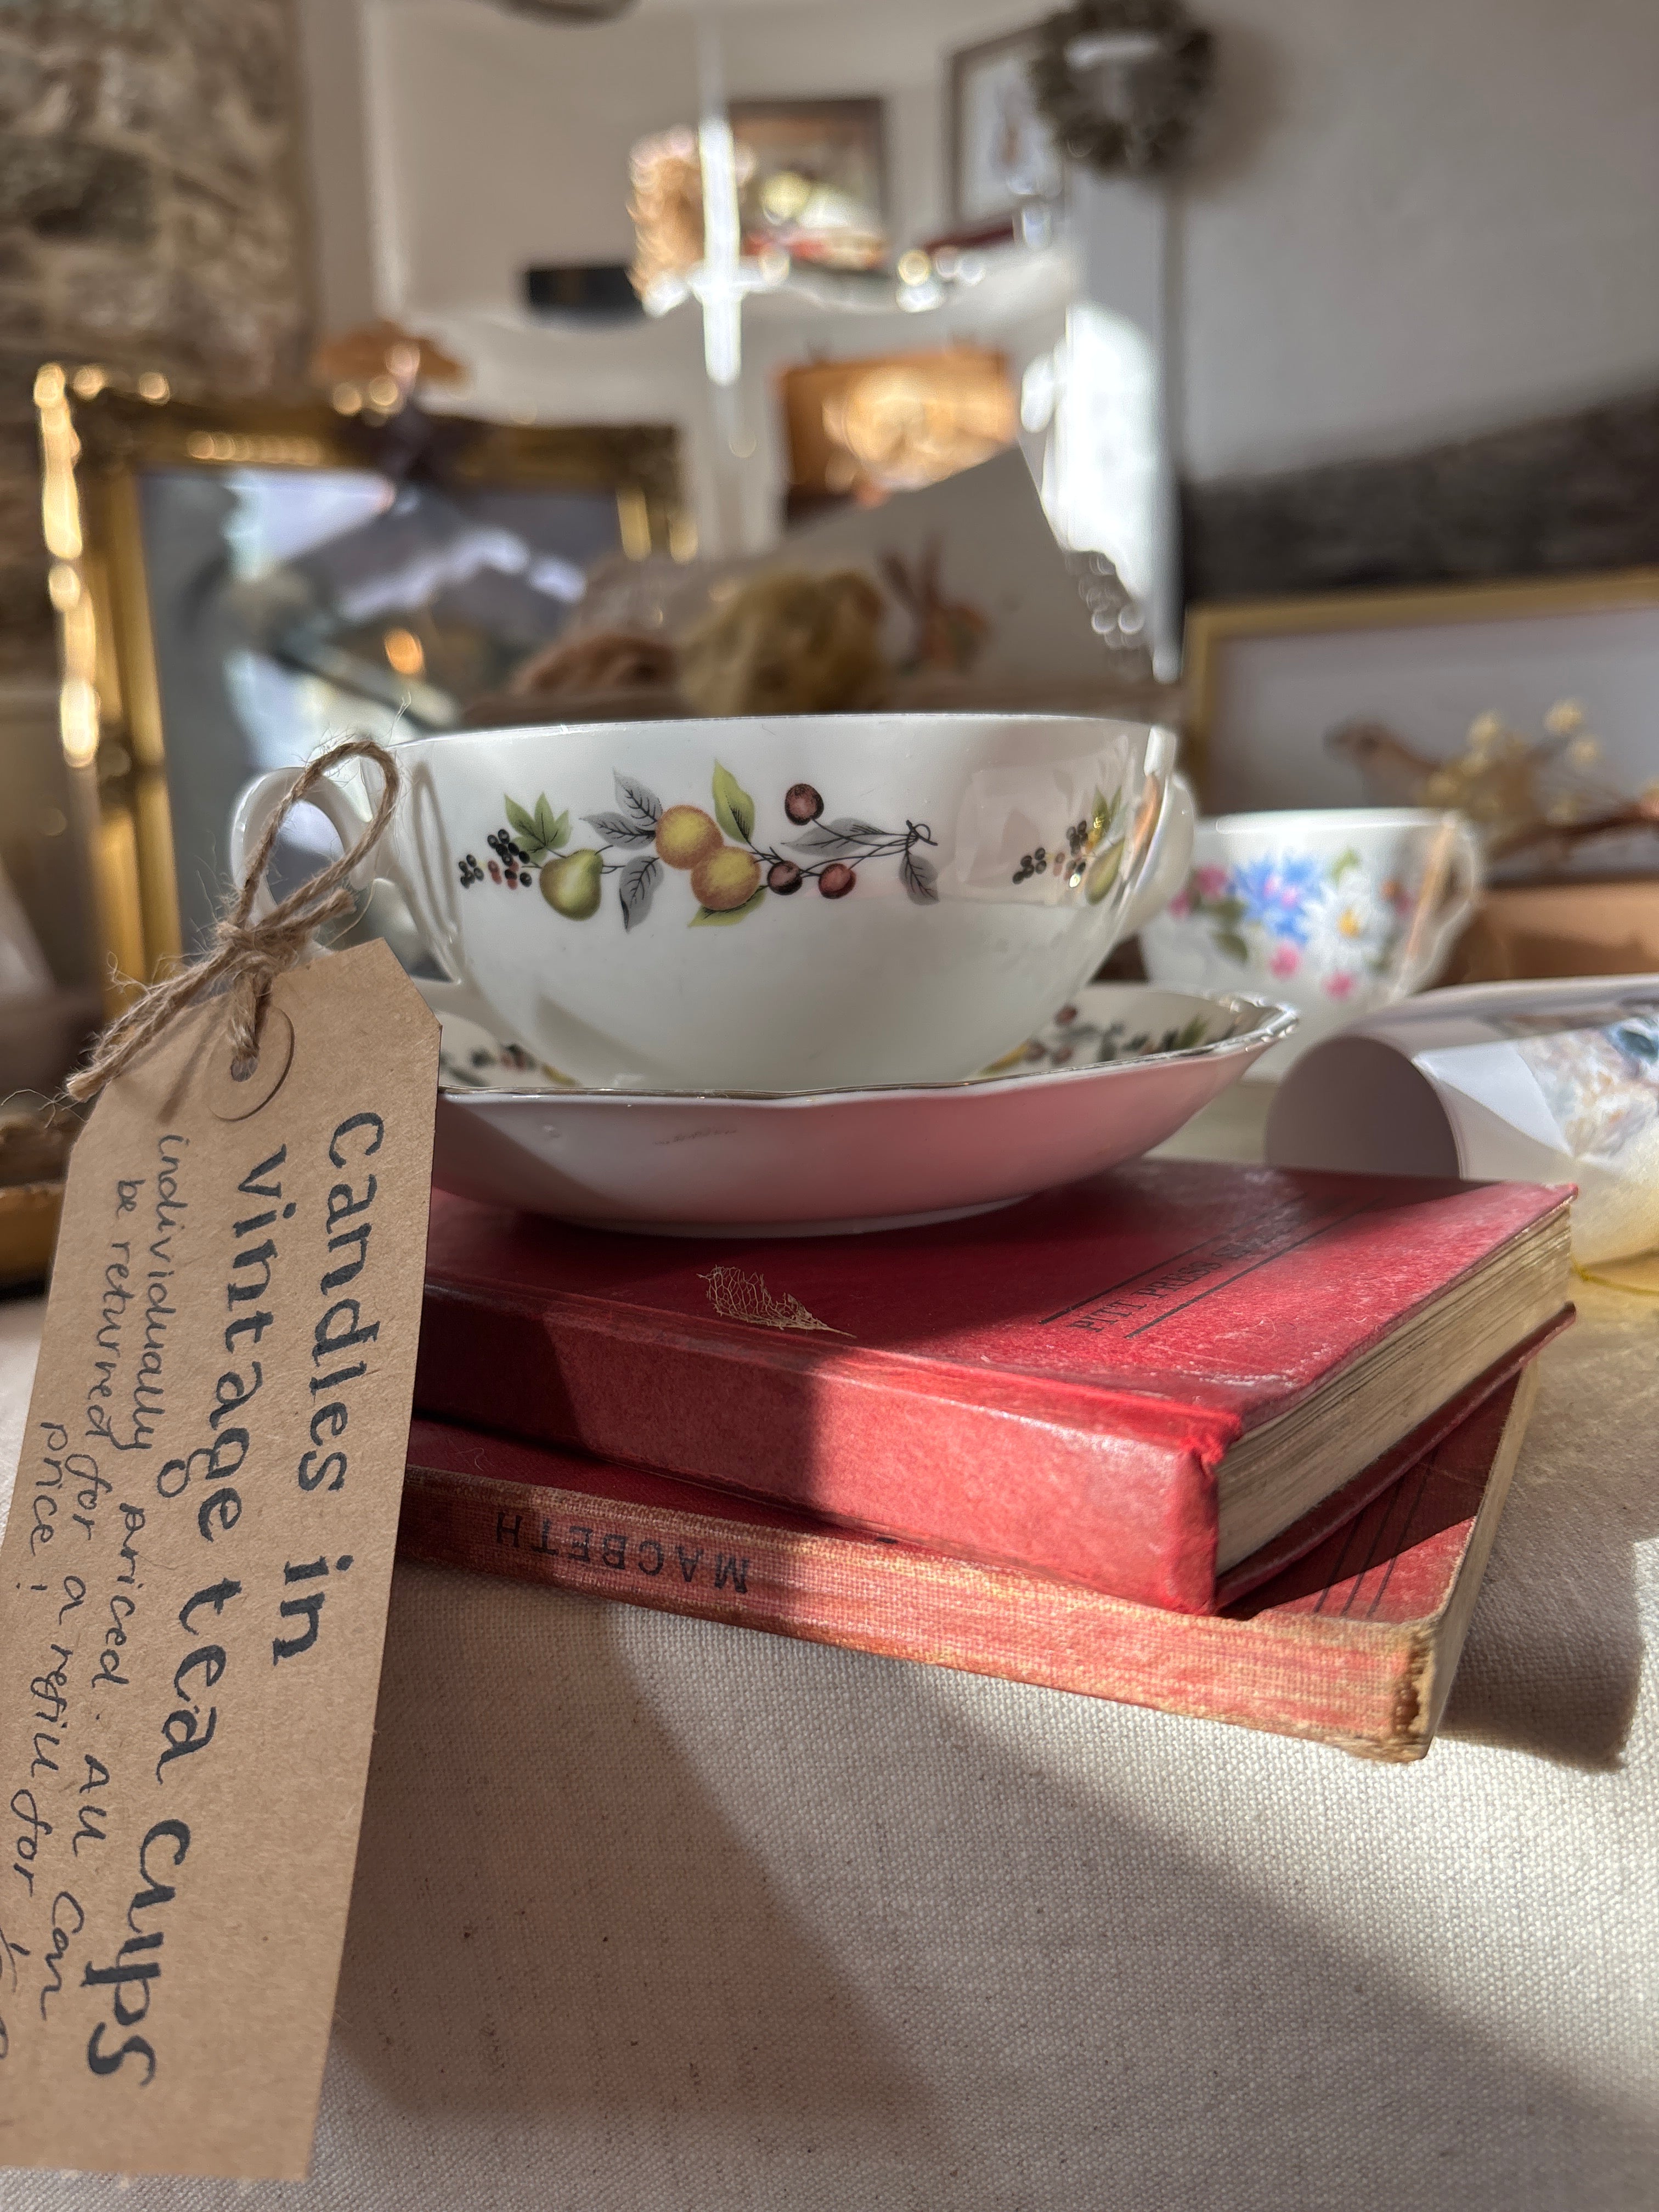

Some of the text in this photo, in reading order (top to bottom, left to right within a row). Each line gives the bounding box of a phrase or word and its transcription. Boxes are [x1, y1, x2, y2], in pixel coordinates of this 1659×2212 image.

[116, 1179, 146, 1216] be
[84, 1241, 131, 1442] returned
[115, 1134, 189, 1451] individually
[1066, 1260, 1223, 1333] PITT PRESS
[64, 1453, 114, 1542] for
[495, 1511, 751, 1594] MACBETH
[58, 1575, 87, 1626] a
[79, 1143, 297, 2086] vintage tea cups
[271, 1554, 356, 1667] in
[30, 1643, 74, 1779] refill
[9, 1788, 54, 1898] for
